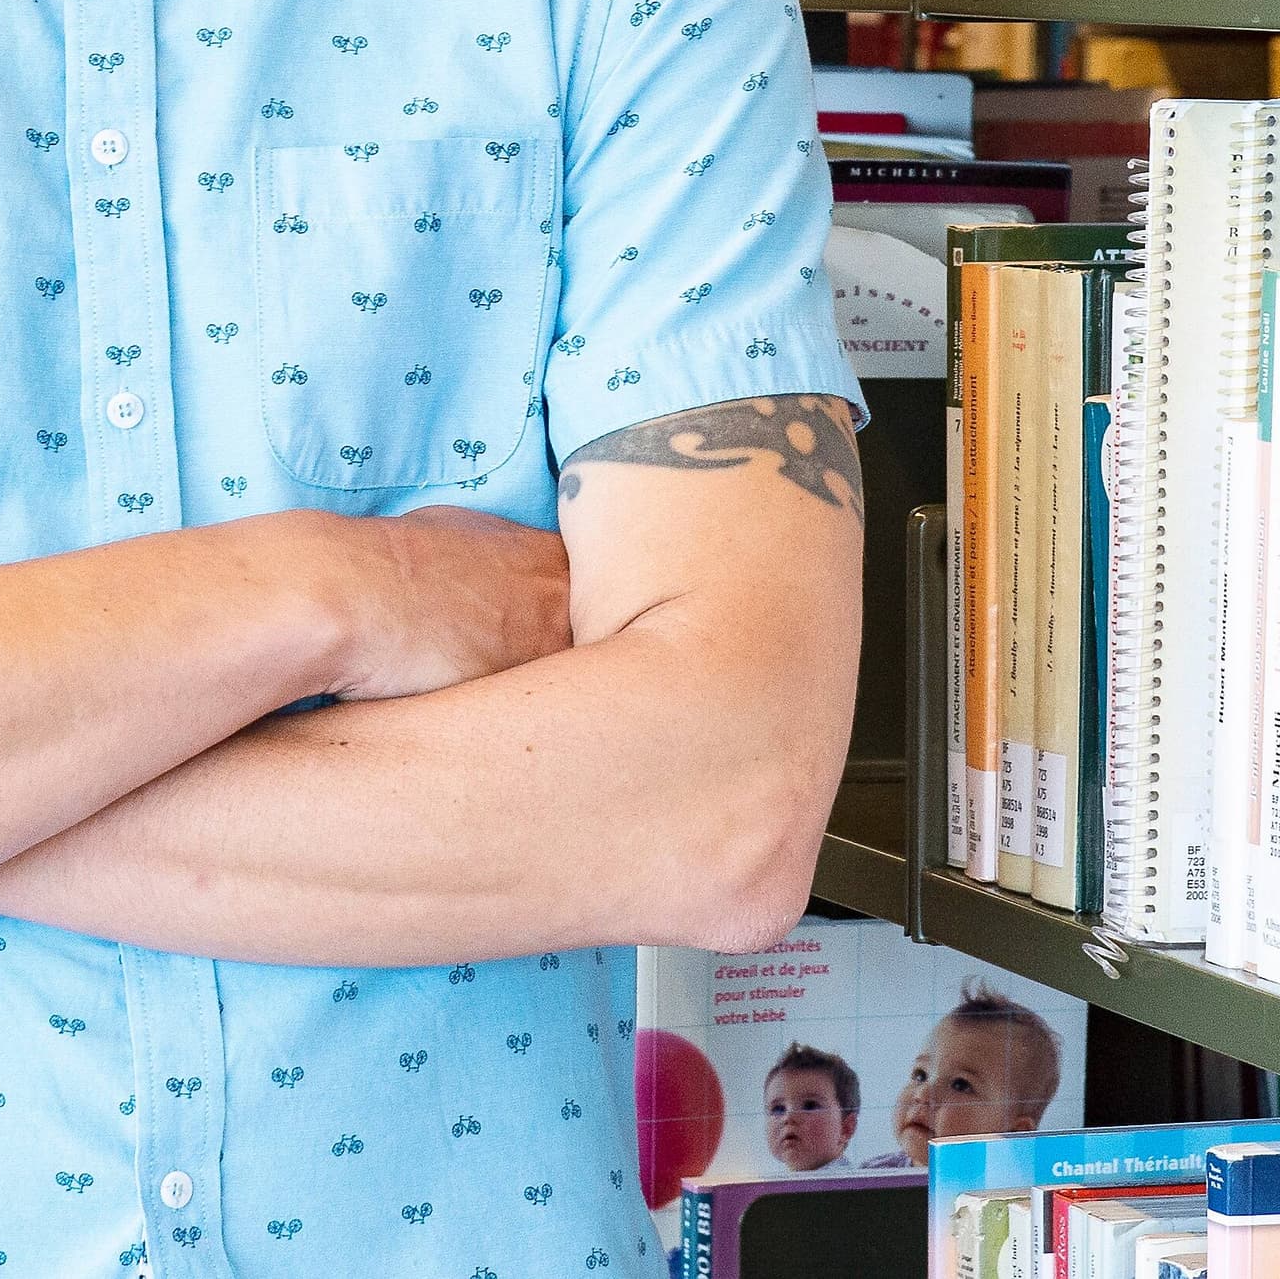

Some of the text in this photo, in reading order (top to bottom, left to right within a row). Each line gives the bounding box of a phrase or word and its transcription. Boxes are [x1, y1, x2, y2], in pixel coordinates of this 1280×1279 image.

[848, 165, 960, 180] MICHELET
[850, 315, 868, 326] de
[1260, 313, 1271, 394] Louise Noël
[1219, 571, 1229, 663] Montagner
[950, 528, 961, 744] ATTACHEMENT ET DÉVELOPPEMENT
[1218, 667, 1226, 725] Hubert
[1002, 760, 1012, 774] 723
[1037, 768, 1047, 782] 723
[1187, 845, 1201, 855] BF
[1187, 856, 1205, 866] 723
[1186, 868, 1206, 878] A75
[1186, 879, 1206, 889] E53
[714, 962, 830, 980] d'éveil et de jeux
[714, 984, 806, 1006] pour stimuler
[713, 1008, 786, 1025] votre bébé
[1051, 1157, 1120, 1177] Chantal
[696, 1201, 711, 1237] BB
